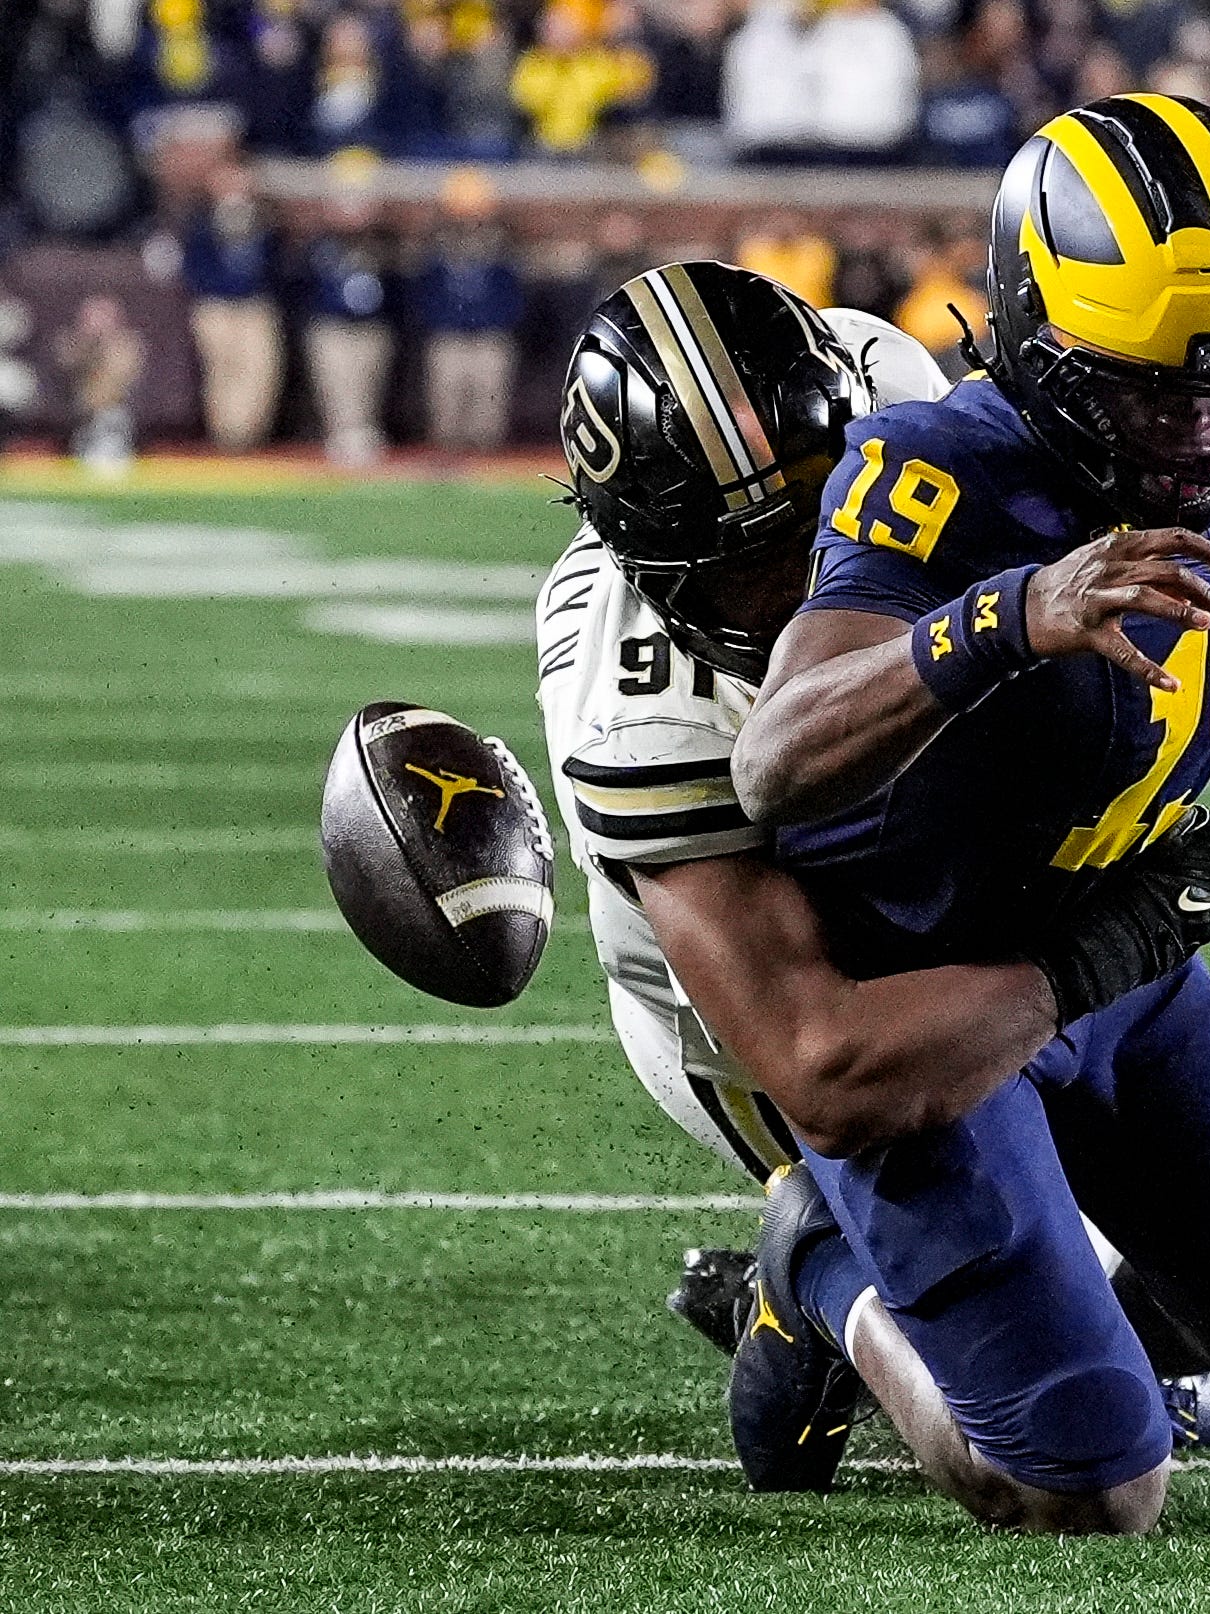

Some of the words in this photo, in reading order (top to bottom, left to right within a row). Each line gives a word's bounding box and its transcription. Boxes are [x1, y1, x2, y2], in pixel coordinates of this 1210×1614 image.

[830, 437, 961, 564] 19
[929, 614, 954, 662] M
[973, 591, 1000, 633] M
[617, 631, 719, 703] 91
